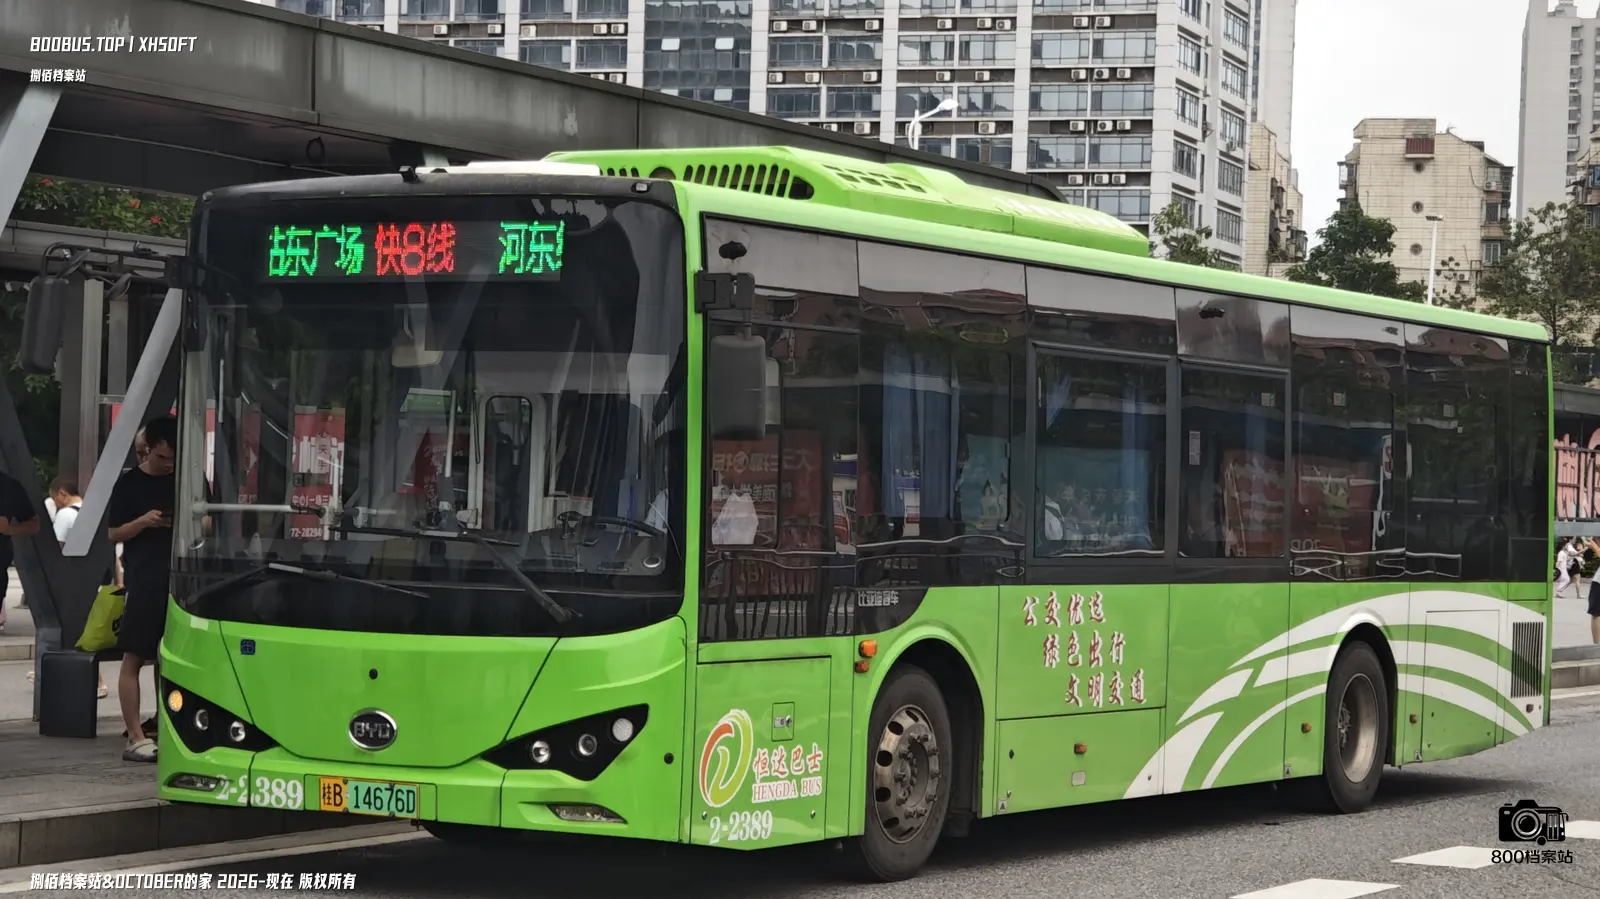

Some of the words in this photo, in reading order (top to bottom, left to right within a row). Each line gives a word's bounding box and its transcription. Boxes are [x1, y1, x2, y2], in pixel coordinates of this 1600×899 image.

[375, 222, 456, 276] 快8线
[858, 590, 899, 607] 比亚迪客车
[1043, 630, 1126, 668] 绿色出行
[1065, 668, 1147, 708] 文明交通
[353, 721, 391, 738] BYD
[752, 743, 823, 781] 恒达巴士
[215, 774, 303, 809] 2-2389
[752, 779, 798, 803] HENGDA
[801, 776, 822, 797] BUS
[709, 810, 773, 844] 2-2389
